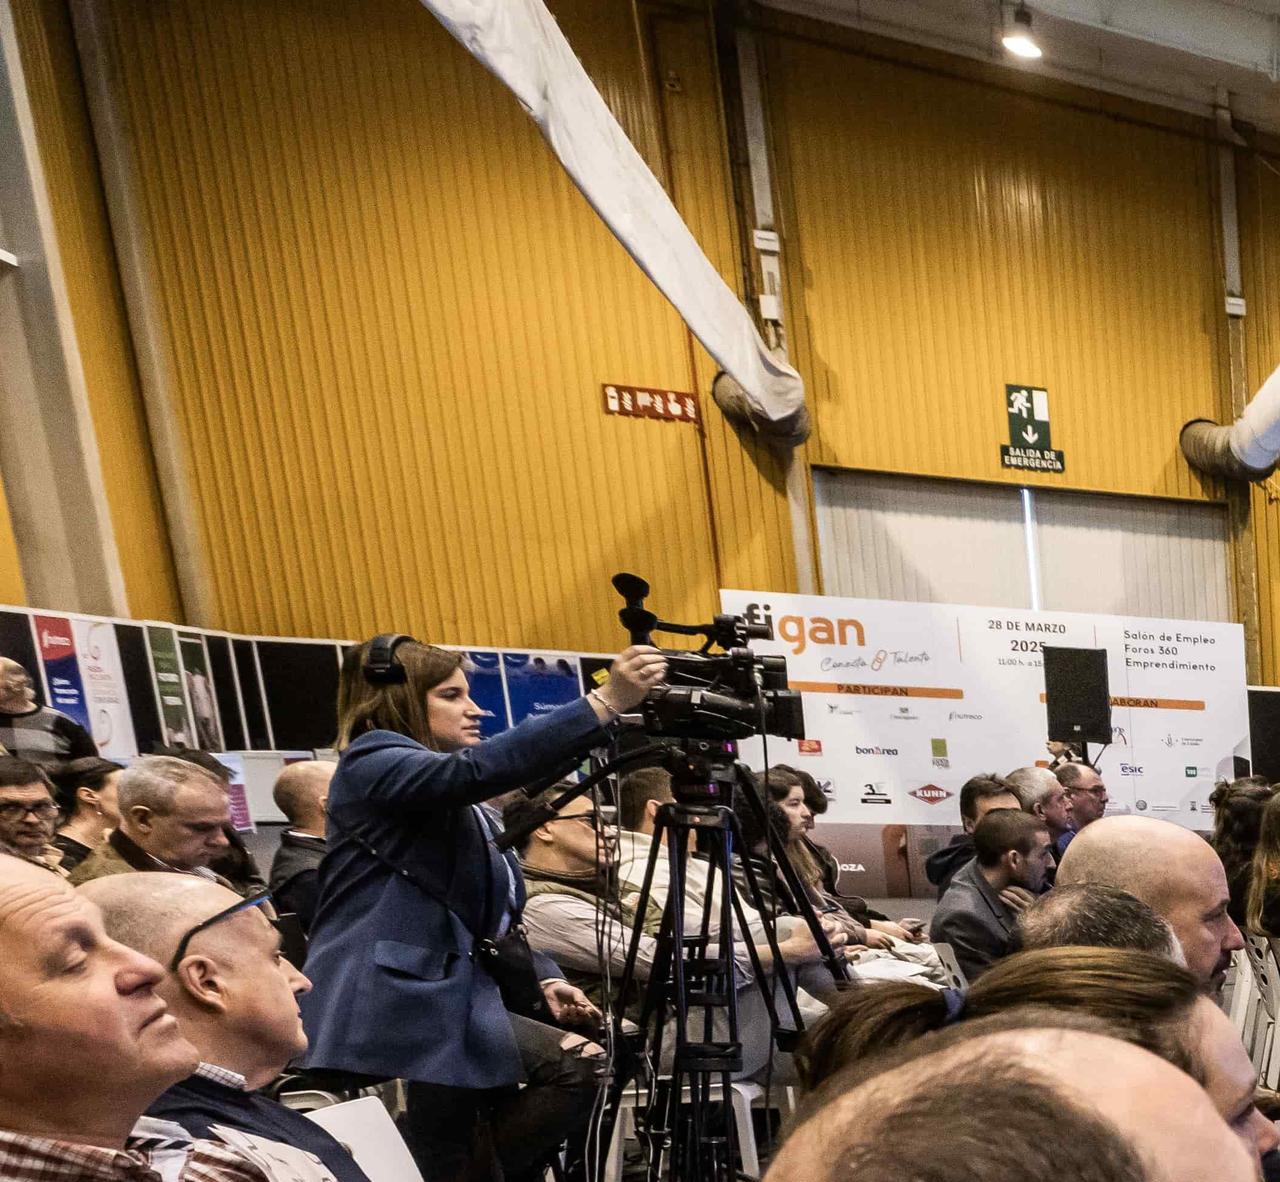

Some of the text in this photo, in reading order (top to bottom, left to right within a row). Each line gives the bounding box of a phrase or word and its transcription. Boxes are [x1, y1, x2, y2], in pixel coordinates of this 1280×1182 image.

[1009, 447, 1056, 460] SALIDA DE
[1004, 456, 1062, 470] EMERGENCIA
[743, 602, 866, 656] figan
[989, 620, 1066, 634] 28 DE MARZO
[1124, 630, 1216, 645] Salón de Empleo
[1010, 640, 1046, 653] 2025
[1124, 644, 1178, 655] Foros 360
[1125, 657, 1216, 672] Emprendimiento
[837, 684, 909, 697] PARTICIPAN
